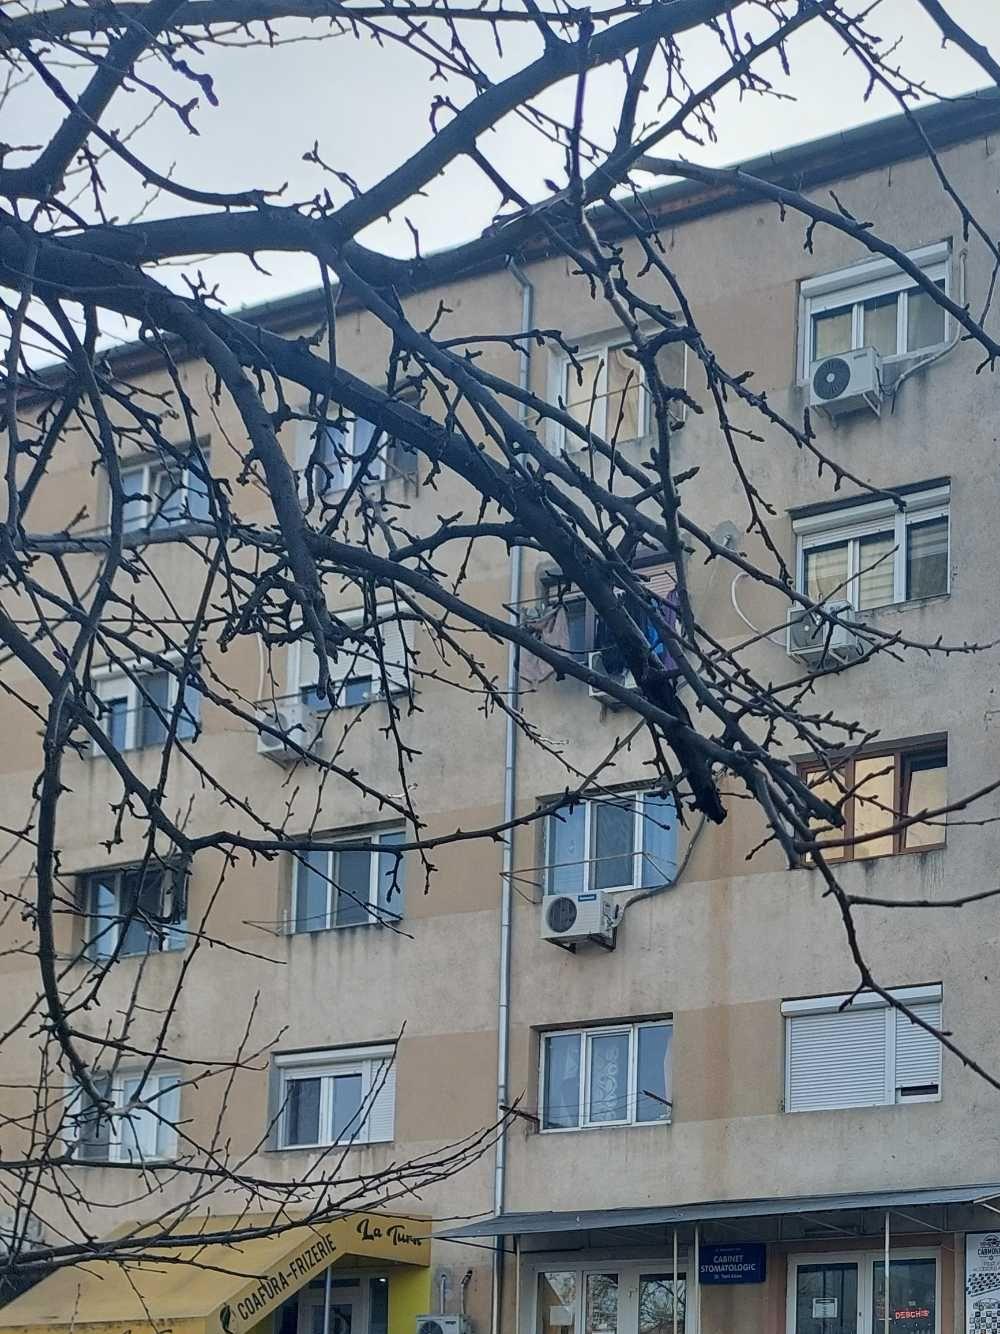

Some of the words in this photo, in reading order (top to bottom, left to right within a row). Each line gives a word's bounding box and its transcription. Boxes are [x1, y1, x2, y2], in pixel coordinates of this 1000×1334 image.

[357, 1218, 382, 1241] La
[713, 1255, 744, 1263] CABINET
[700, 1263, 756, 1273] STOMATOLOGIC
